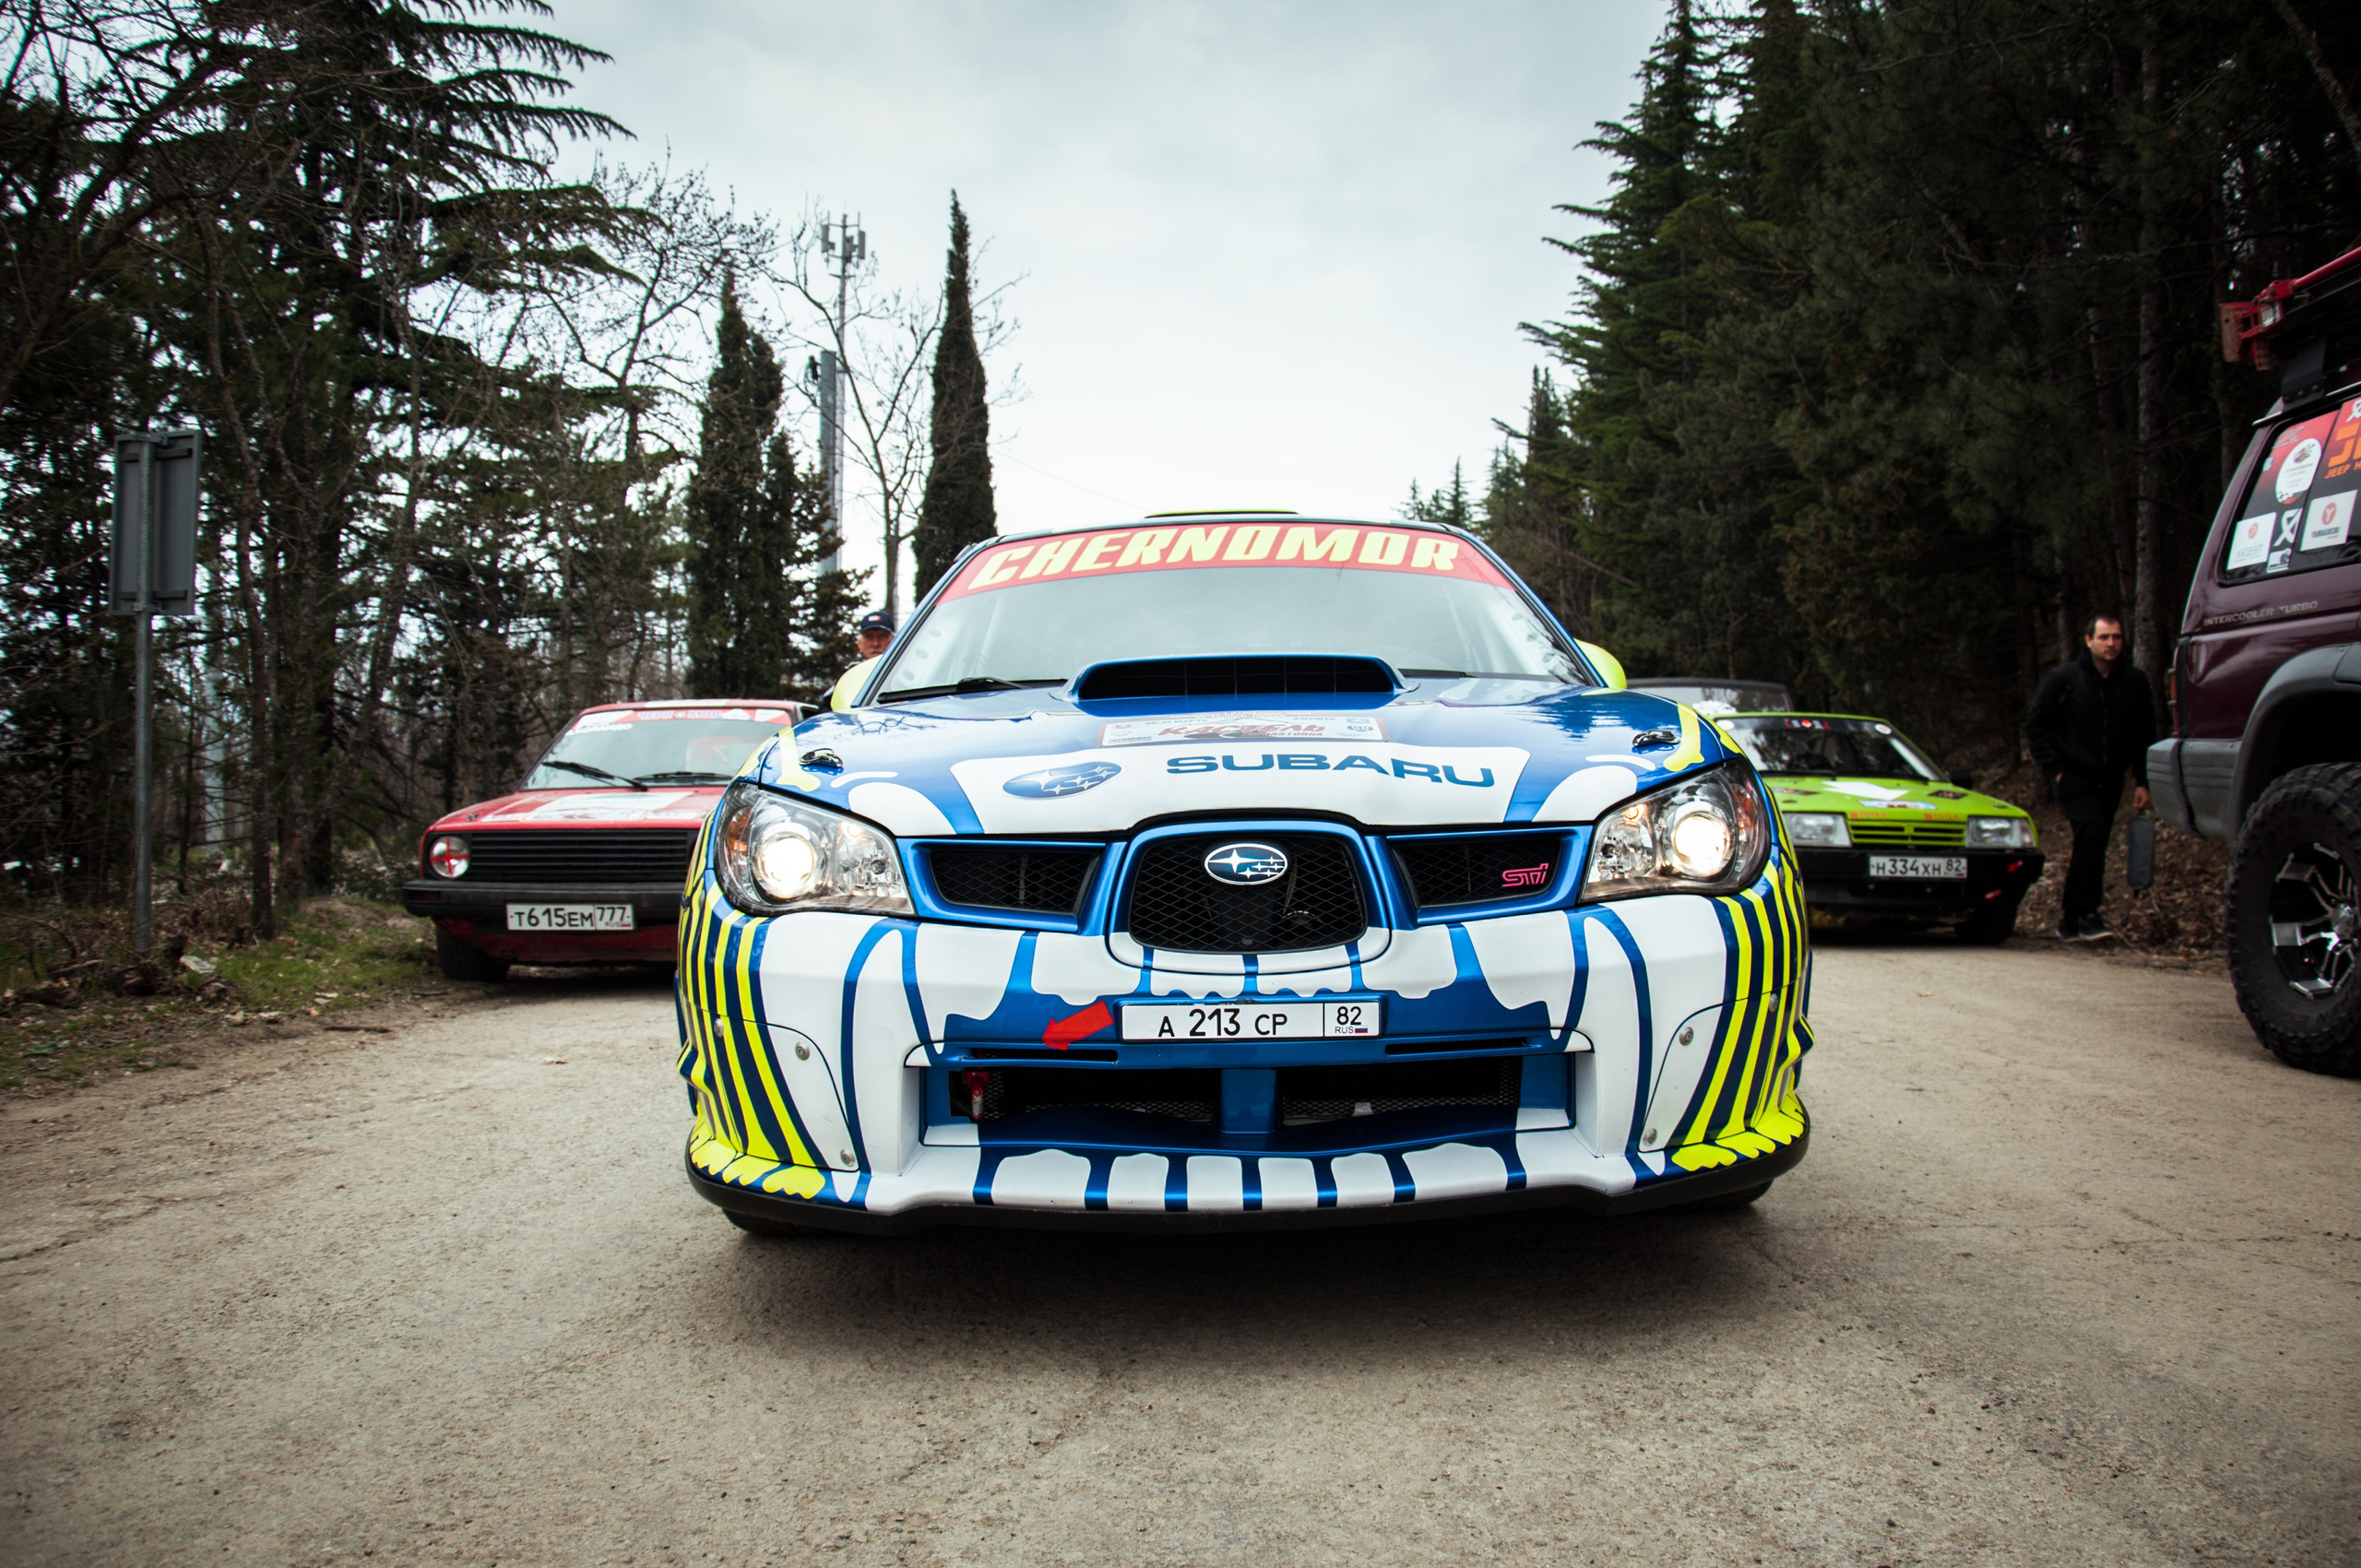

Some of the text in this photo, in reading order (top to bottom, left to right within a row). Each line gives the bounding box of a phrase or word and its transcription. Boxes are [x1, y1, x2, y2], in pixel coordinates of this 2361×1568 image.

[2324, 463, 2351, 480] JEEP
[966, 524, 1461, 590] CHERNOMOR
[2203, 600, 2319, 626] INTERCOOLER TURBO
[1167, 754, 1495, 788] SUBARU
[1945, 859, 1962, 873] 82
[514, 907, 626, 928] Т615ЕМ 777
[1189, 1008, 1241, 1037] 213
[1336, 1005, 1362, 1026] 82
[1335, 1026, 1354, 1034] RUS
